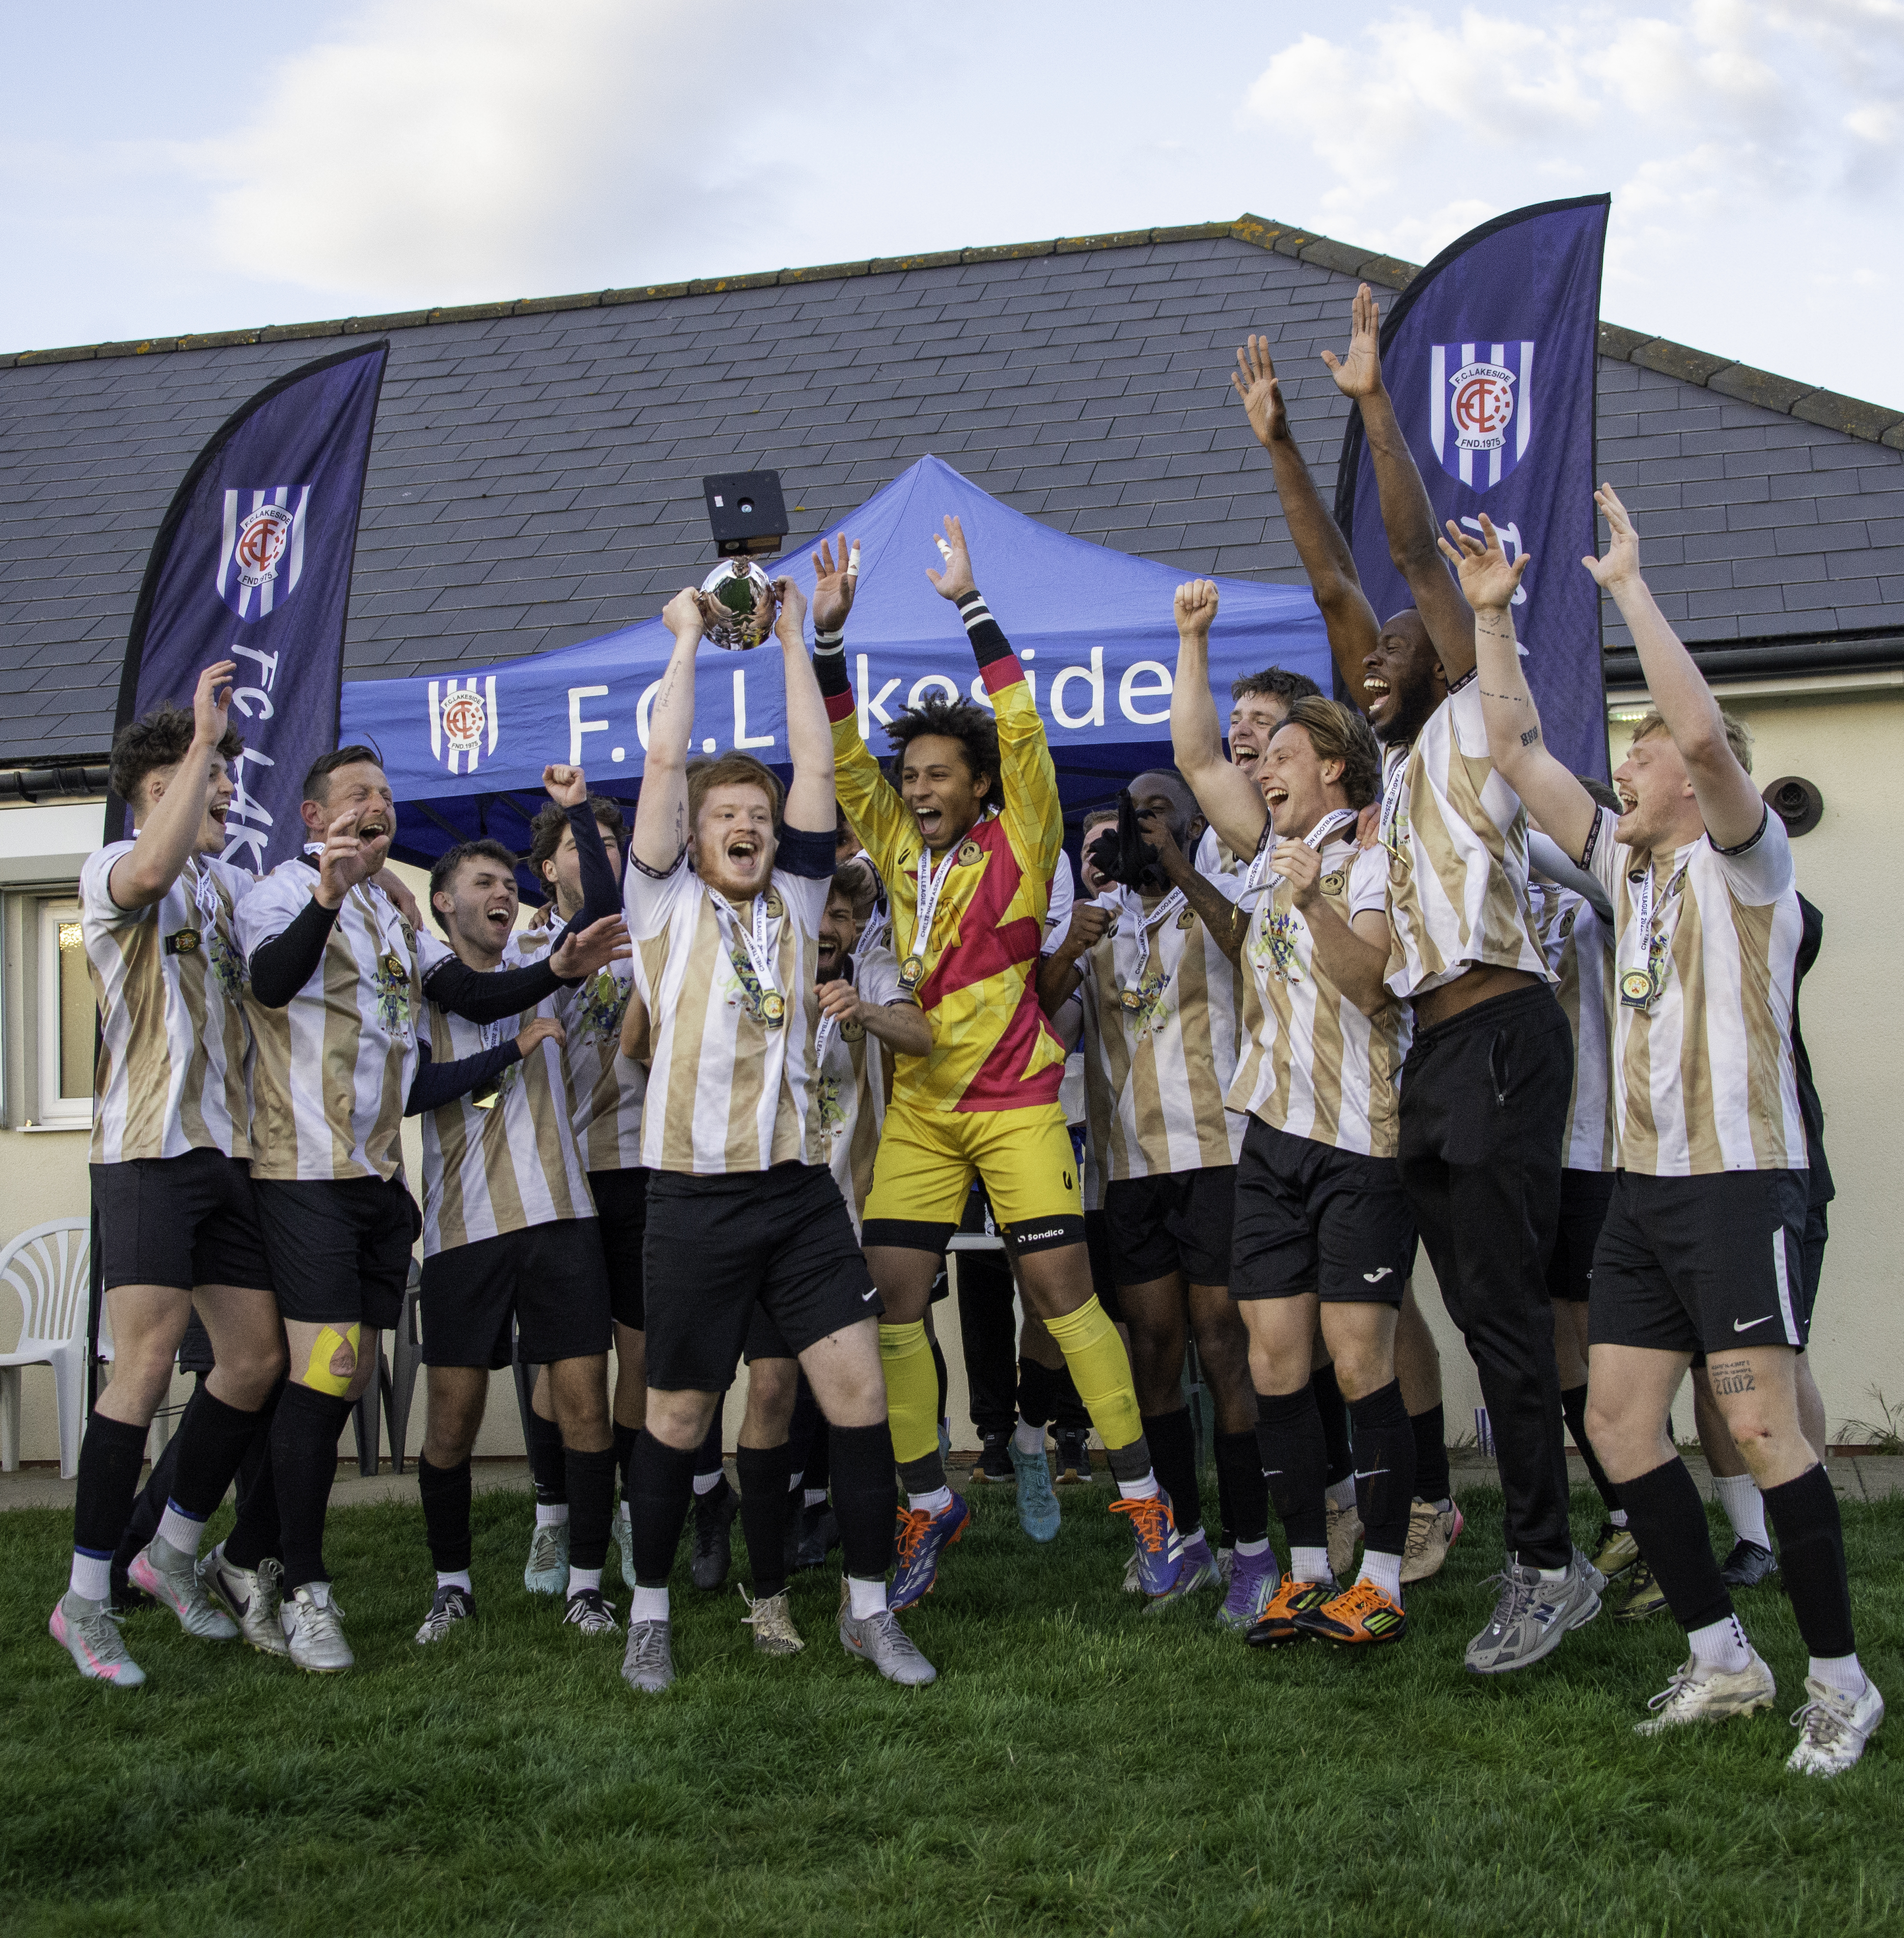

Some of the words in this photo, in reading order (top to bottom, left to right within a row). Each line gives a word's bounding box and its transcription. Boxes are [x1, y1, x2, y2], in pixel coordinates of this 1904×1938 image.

[1455, 368, 1511, 385] F.C.LAKESIDE
[1460, 437, 1501, 448] FND.1975
[231, 644, 278, 720] FC
[444, 694, 482, 707] F.C.LAKESIDE
[451, 740, 478, 749] FND.1975
[1389, 770, 1401, 796] LEAGUE
[1382, 797, 1393, 826] 2025/2026
[1313, 814, 1338, 839] FOOTBALL
[920, 897, 934, 938] CHELTENHAM
[933, 857, 951, 896] ASSOCIATION
[743, 933, 765, 972] CHELTENHAM
[1135, 939, 1147, 975] CHELTENHAM
[1028, 1229, 1064, 1241] Sondico
[1713, 1374, 1755, 1396] 2002
